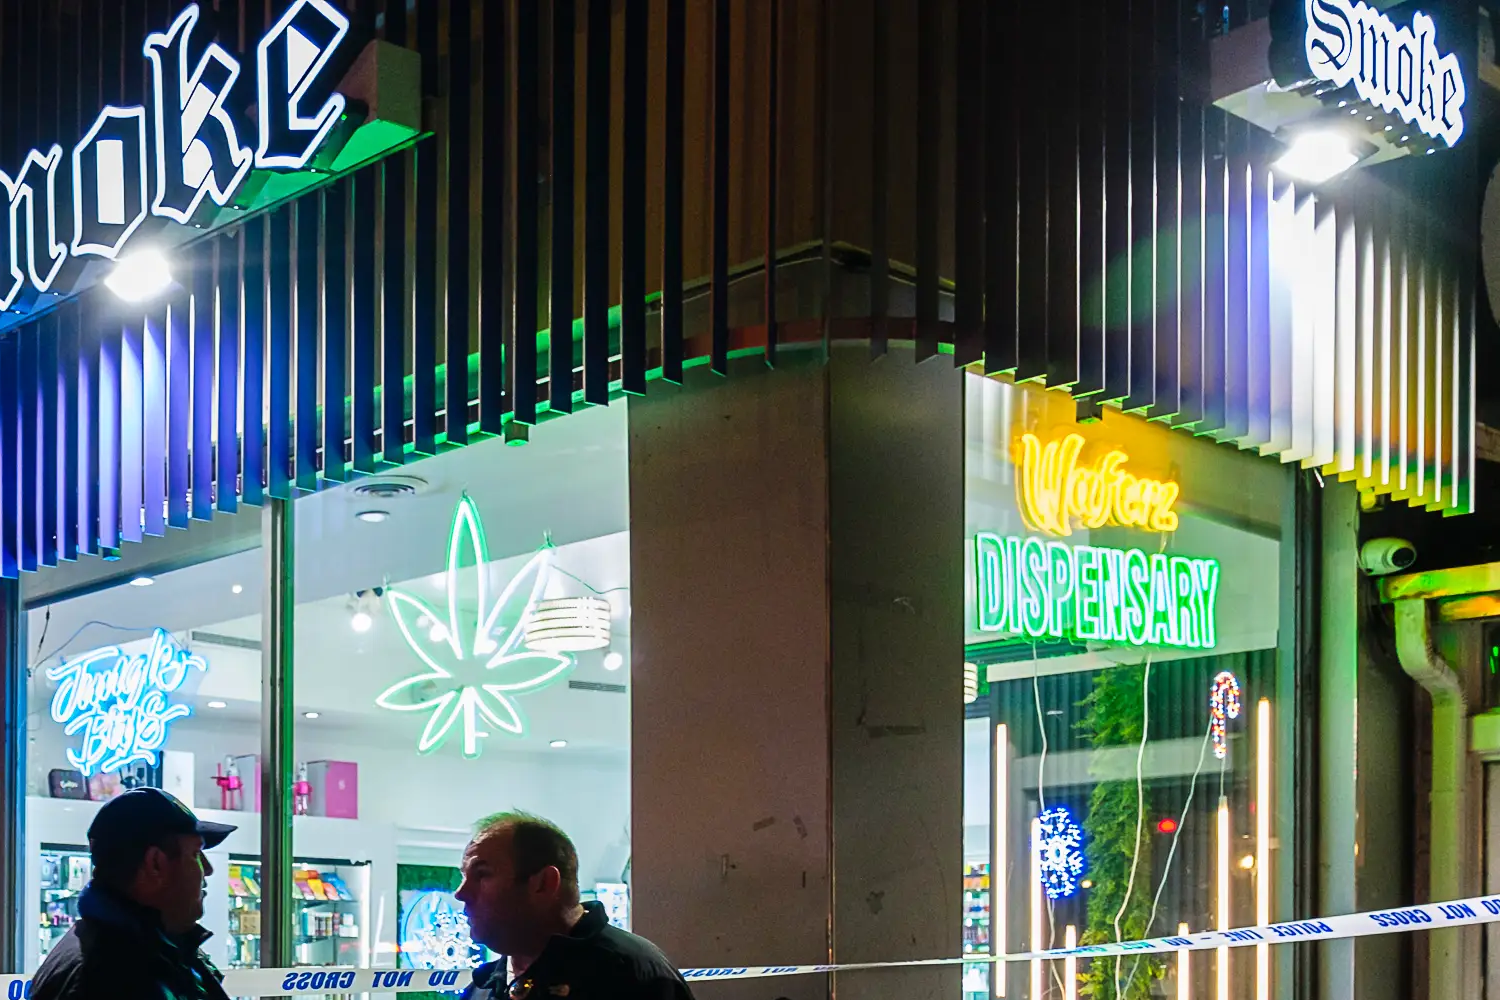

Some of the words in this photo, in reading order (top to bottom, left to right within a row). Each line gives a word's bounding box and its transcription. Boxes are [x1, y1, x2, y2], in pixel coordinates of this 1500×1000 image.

[1306, 0, 1464, 145] Smoke
[974, 532, 1220, 648] DISPENSARY
[1369, 909, 1432, 927] CROSS
[1437, 903, 1477, 920] NOT
[1218, 929, 1263, 942] LINE
[1266, 921, 1333, 937] POLICE
